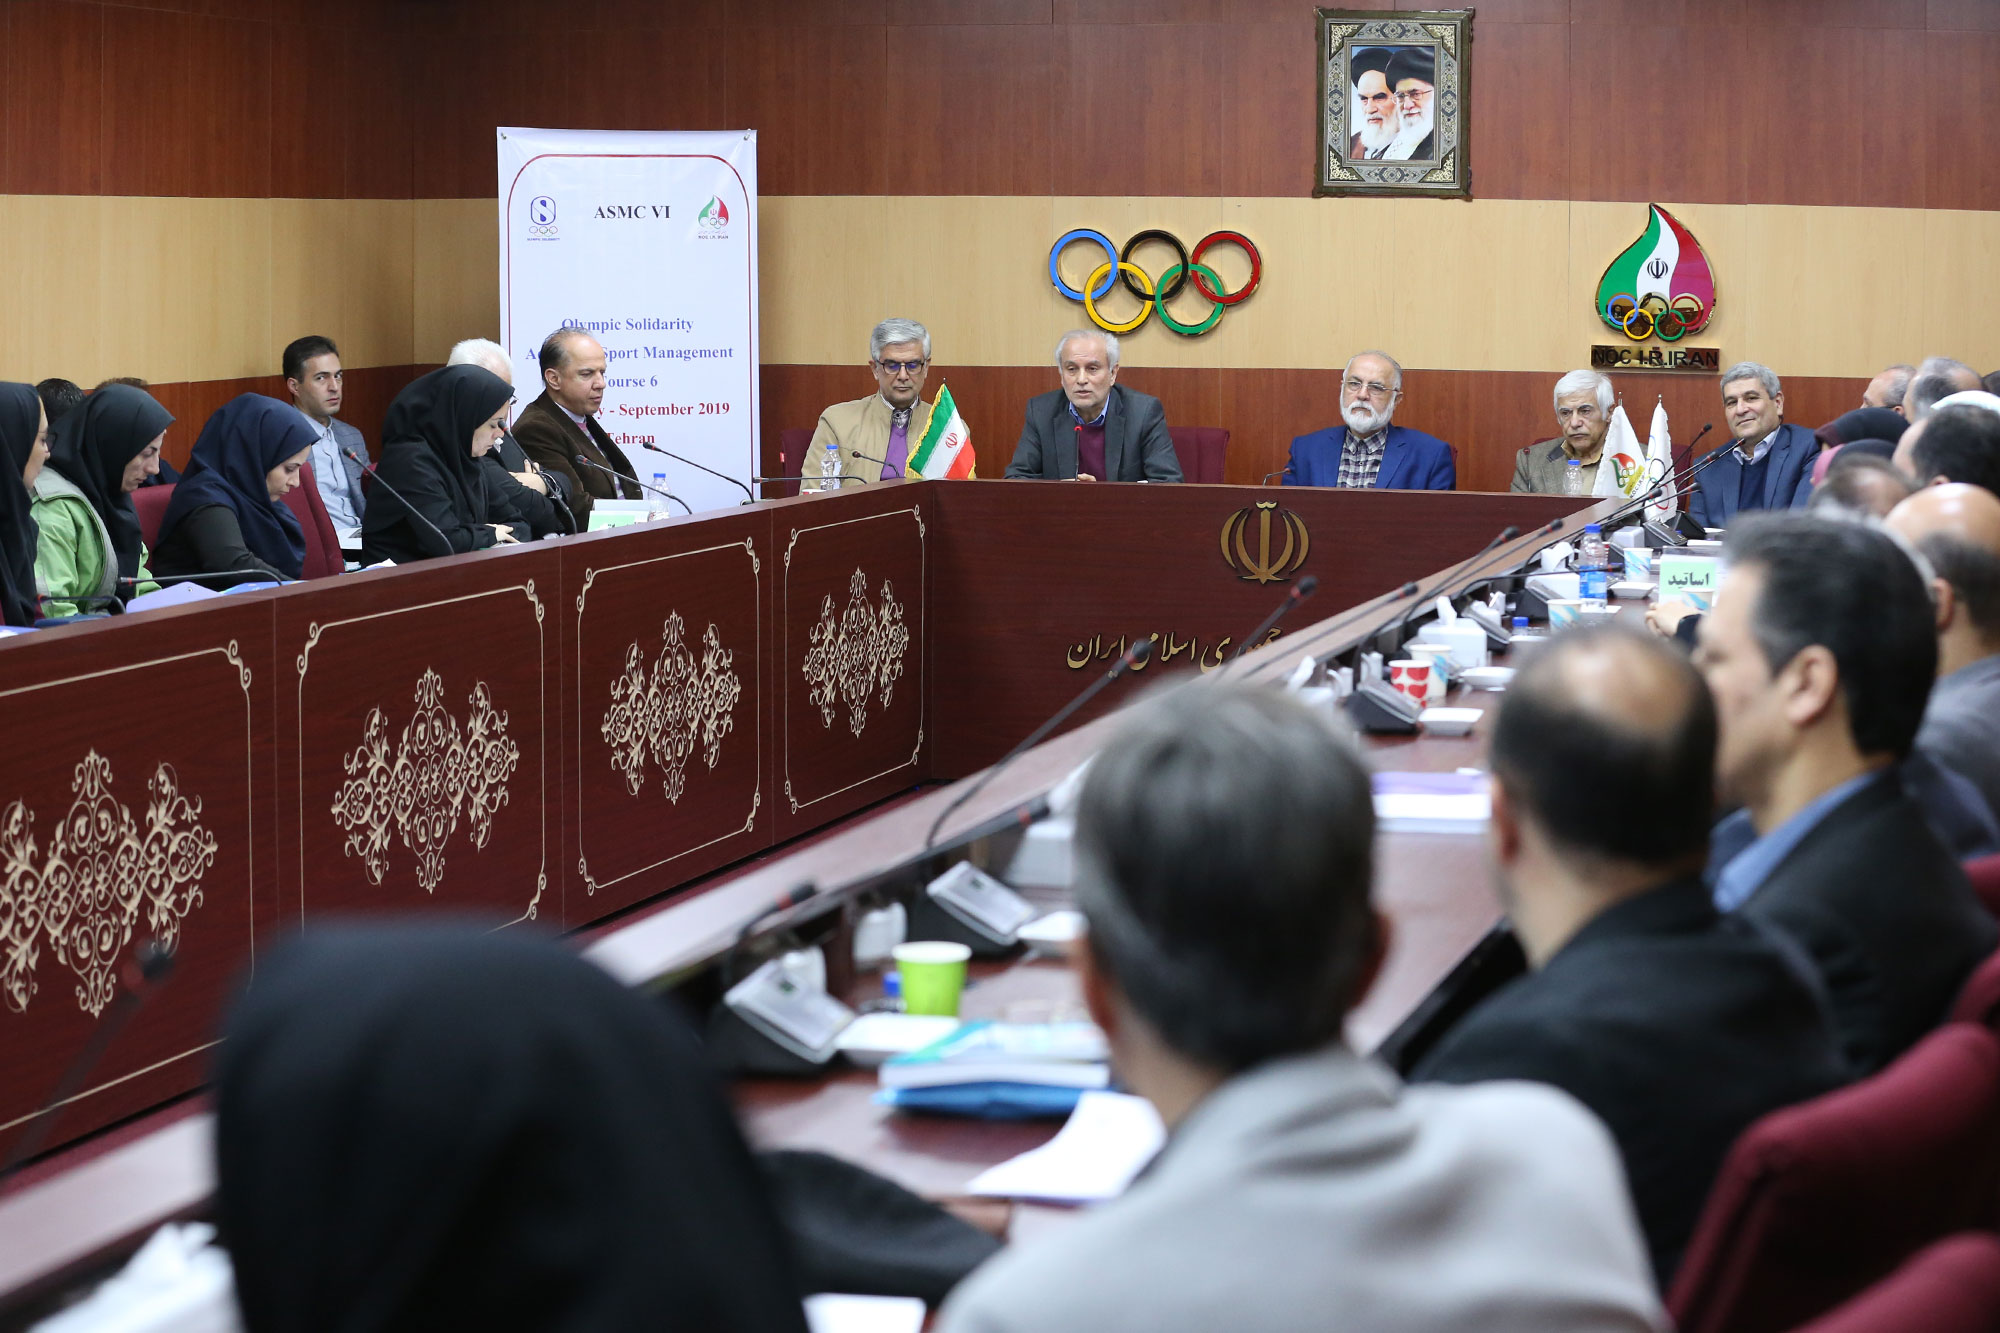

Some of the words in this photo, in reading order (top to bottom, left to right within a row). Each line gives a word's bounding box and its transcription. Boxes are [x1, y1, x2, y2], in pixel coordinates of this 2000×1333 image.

[594, 205, 646, 219] ASMC
[651, 205, 671, 219] VI
[561, 318, 621, 333] Olympic
[625, 317, 694, 333] Solidarity
[643, 346, 733, 361] Management
[1593, 349, 1631, 364] NOC
[604, 375, 646, 387] ourse
[650, 374, 658, 387] 6
[619, 403, 694, 419] September
[698, 402, 730, 415] 2019
[1668, 571, 1709, 589] اساتید
[1067, 634, 1125, 677] ایران
